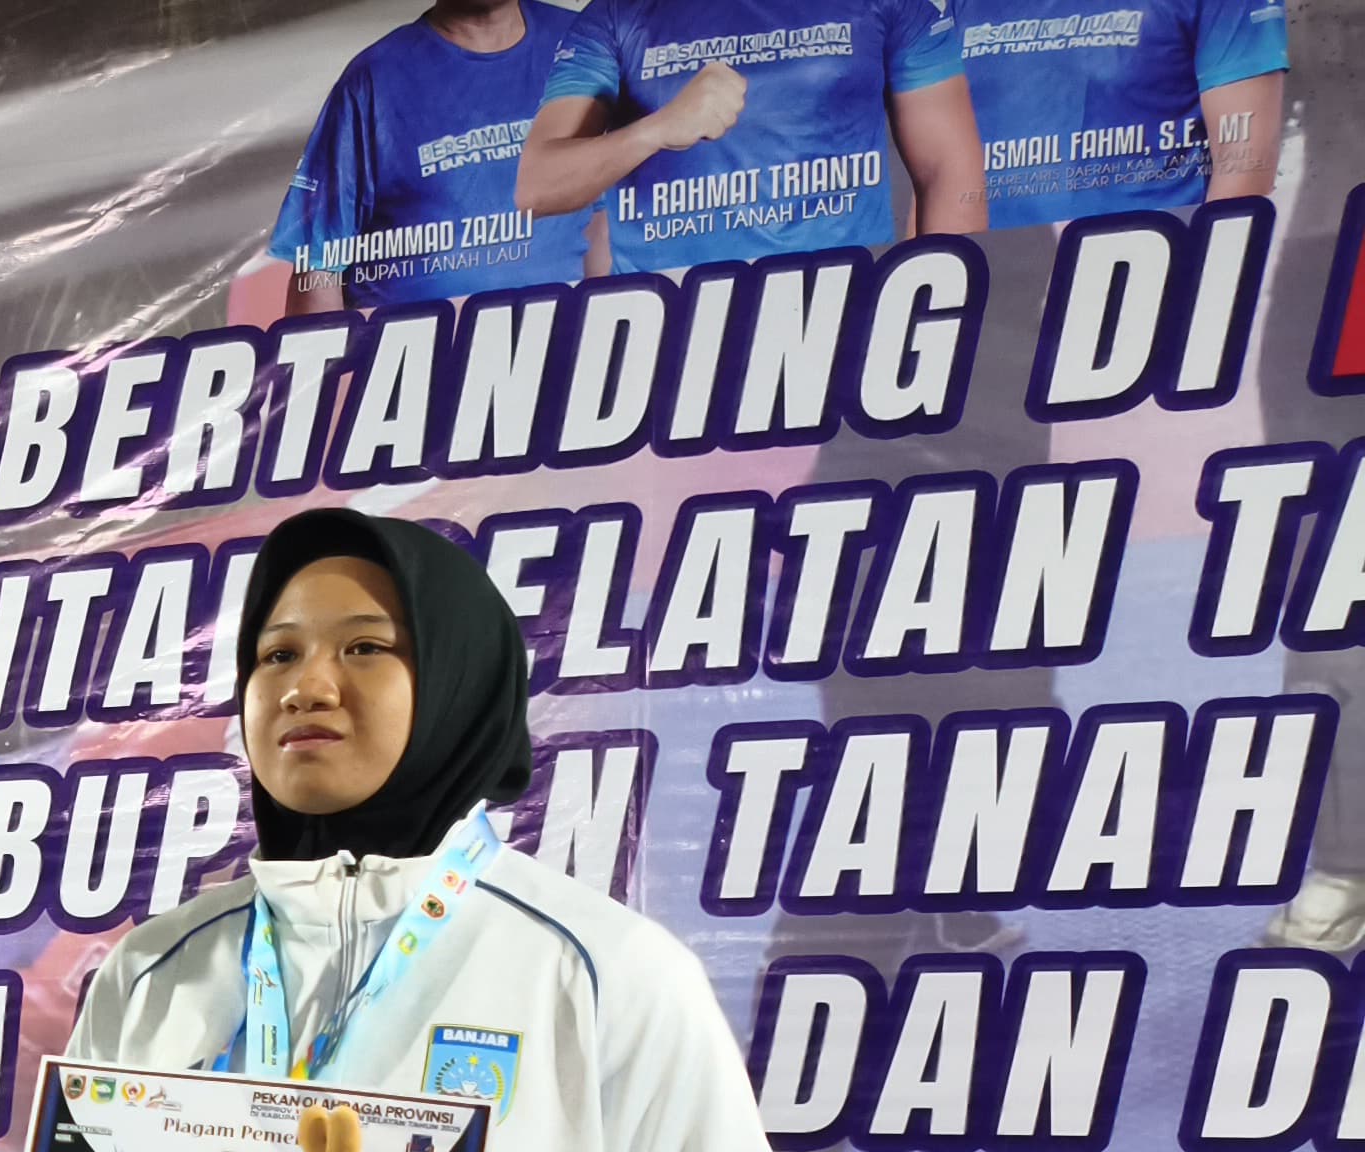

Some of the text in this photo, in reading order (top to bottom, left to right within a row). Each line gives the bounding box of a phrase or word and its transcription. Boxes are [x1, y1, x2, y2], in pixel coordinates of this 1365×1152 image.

[643, 36, 738, 68] BERSAMA
[789, 23, 851, 47] JUARA
[780, 45, 853, 61] PANDANG
[418, 123, 509, 165] BERSAMA
[486, 144, 522, 162] TUNT
[984, 134, 1061, 171] ISMAIL
[1070, 124, 1151, 160] FAHMI,
[1219, 111, 1254, 143] MT
[619, 150, 881, 222] H. RAHMAT TRIANTO
[295, 208, 534, 275] H. MUHAMMAD ZAZULI
[644, 193, 857, 242] BUPATI TANAH LAUT
[297, 242, 531, 293] WAKIL BUPATI TANAH LAUT
[1045, 213, 1254, 406] DI
[481, 475, 1124, 682] ELATAN
[717, 711, 1319, 903] TANAH
[442, 1028, 509, 1048] BANJAR
[766, 966, 1117, 1139] DAN
[163, 1117, 300, 1145] Piagam Peme
[253, 1091, 299, 1107] PEKAN
[385, 1106, 456, 1125] PROVINSI
[261, 1112, 297, 1121] KABUPA
